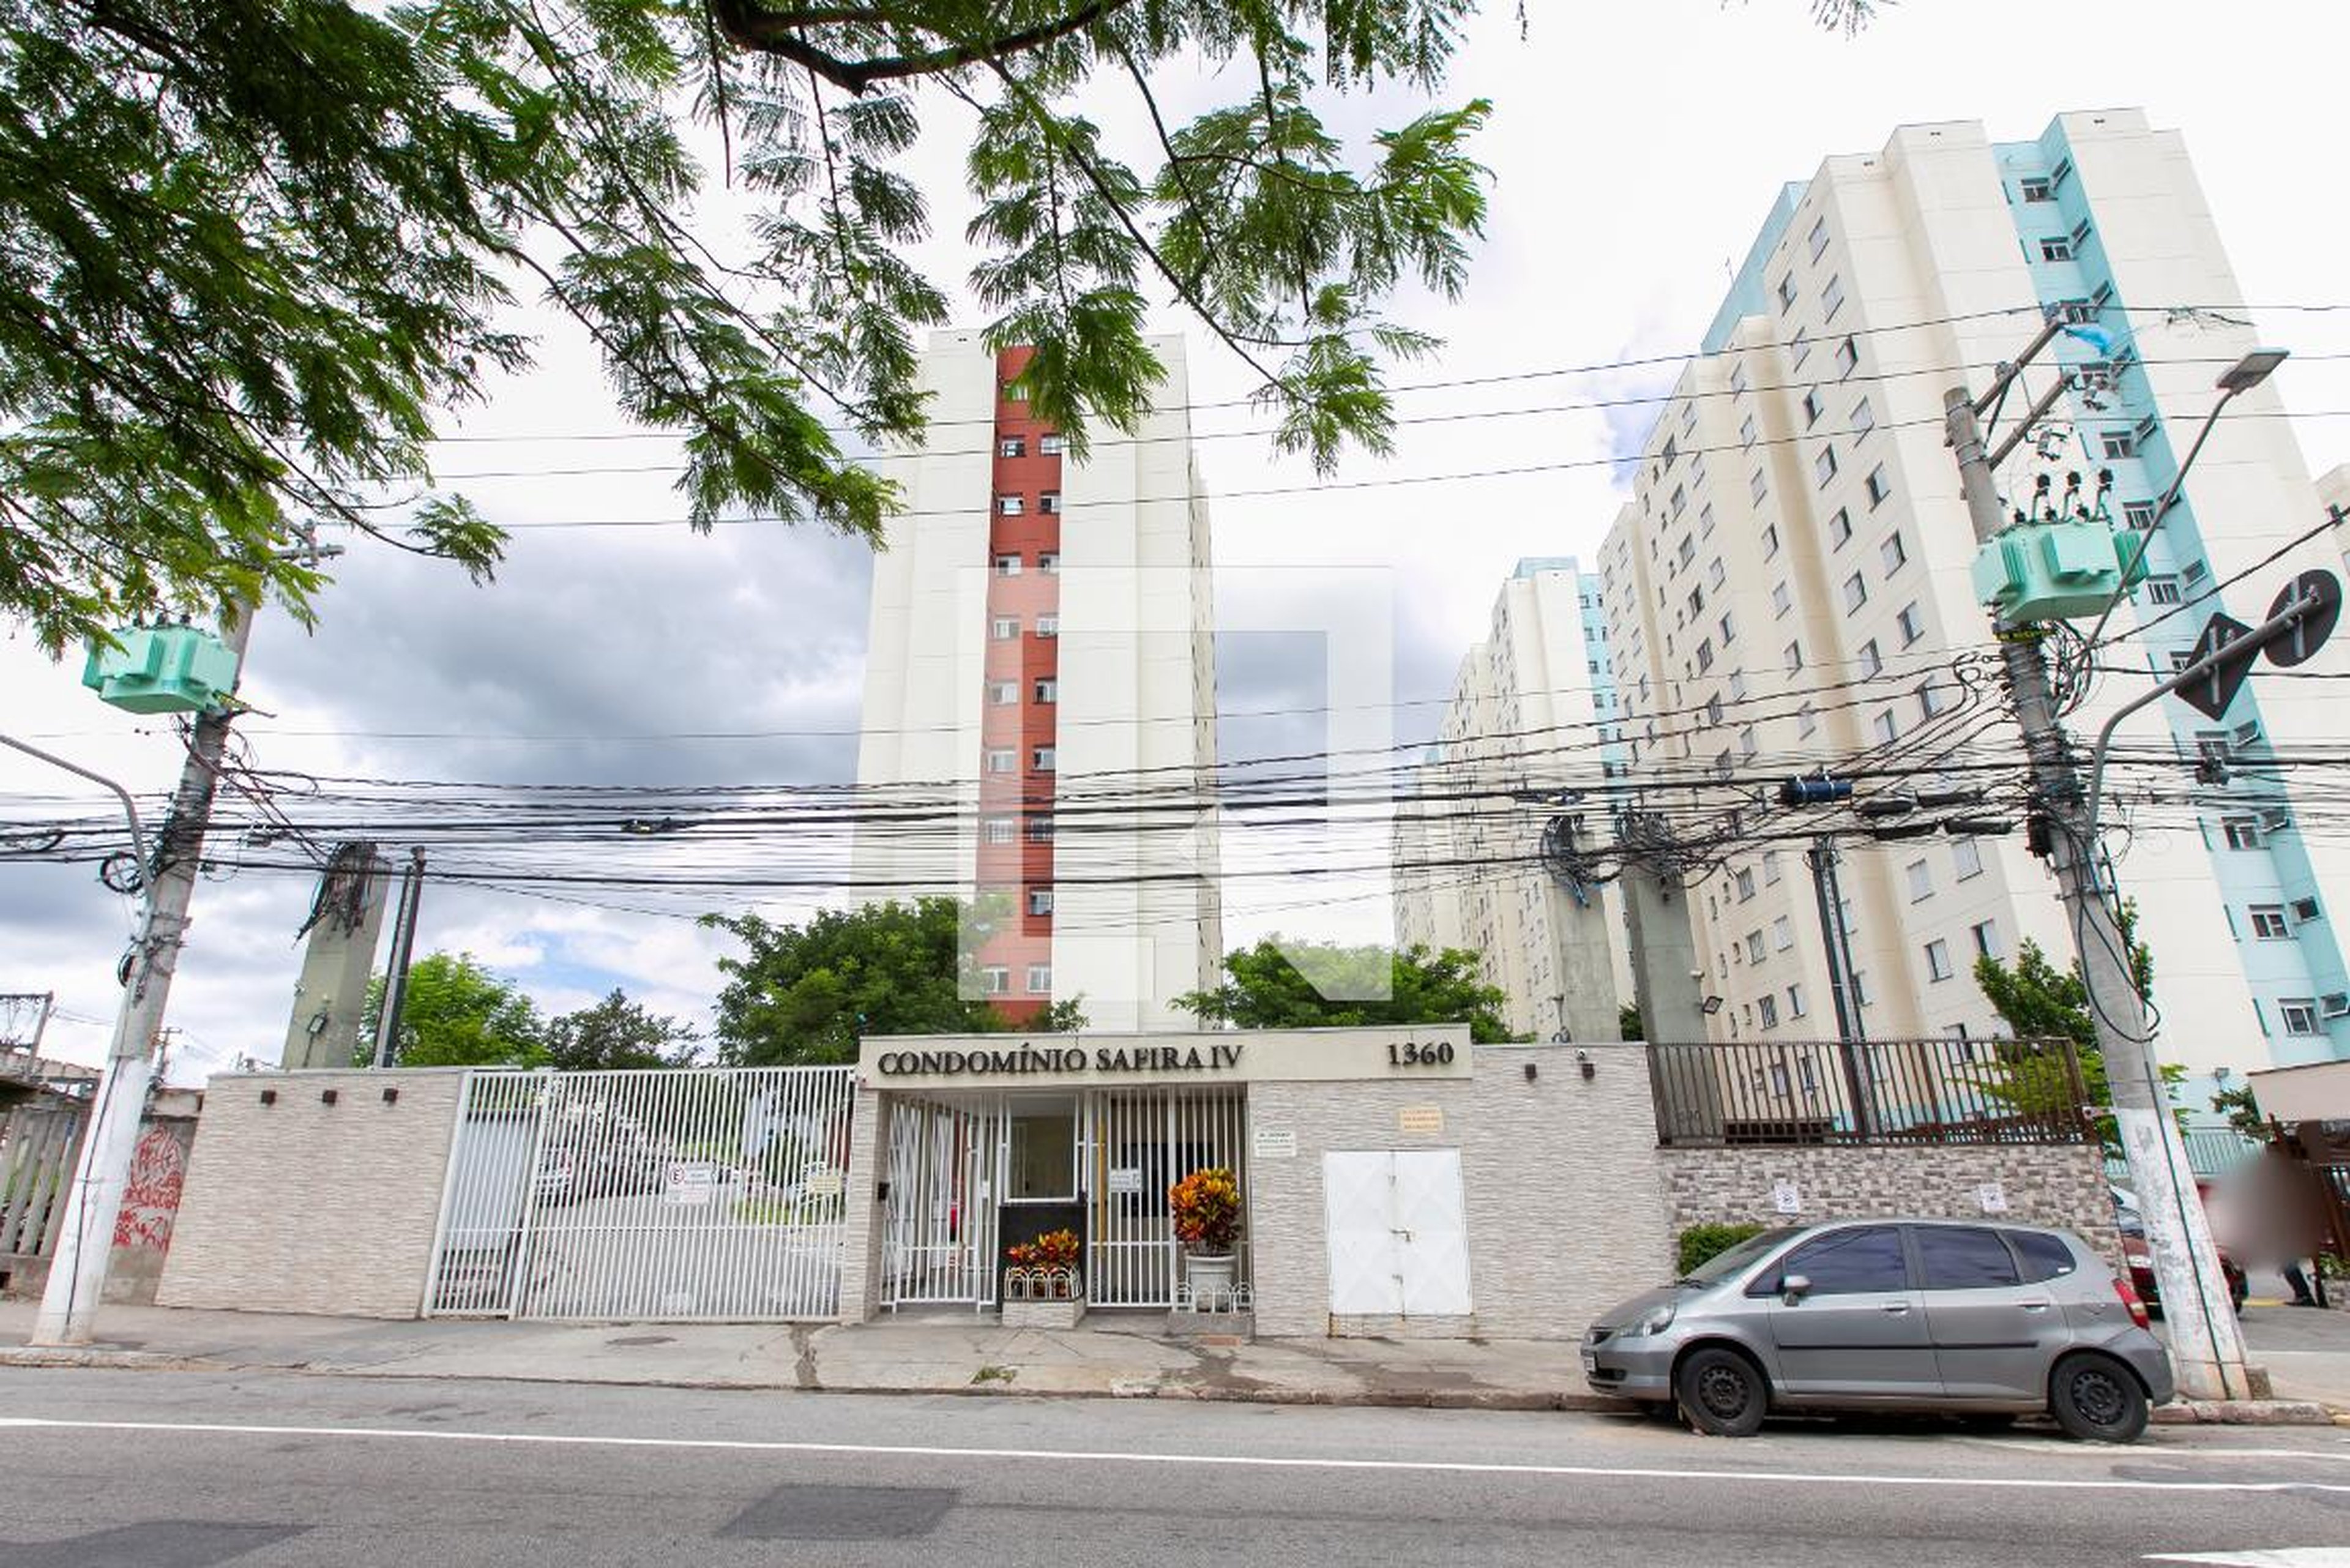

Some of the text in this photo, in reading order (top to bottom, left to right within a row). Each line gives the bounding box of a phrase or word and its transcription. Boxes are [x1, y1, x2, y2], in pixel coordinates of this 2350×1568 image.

[878, 1042, 1244, 1075] CONDOMÍNIO SAFIRA IV
[1387, 1042, 1454, 1066] 1360
